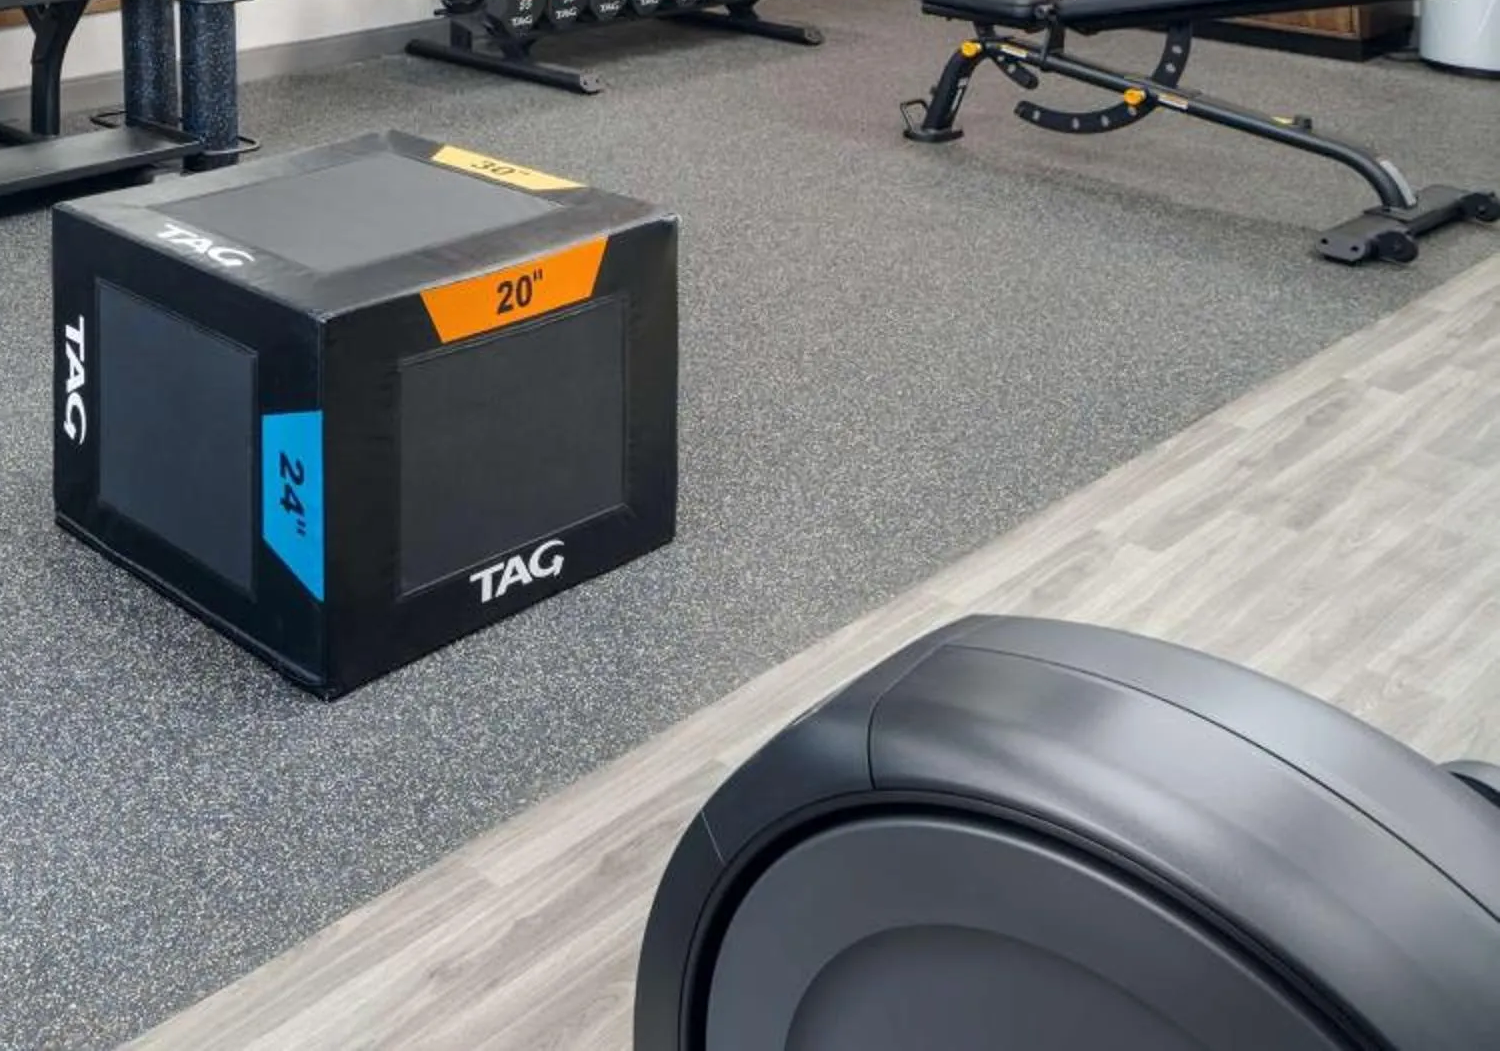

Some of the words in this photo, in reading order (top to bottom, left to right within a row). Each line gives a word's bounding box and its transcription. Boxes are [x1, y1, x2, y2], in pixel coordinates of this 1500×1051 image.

[471, 160, 530, 176] 30"
[155, 222, 256, 268] TAG
[496, 269, 544, 315] 20"
[63, 314, 87, 446] TAG
[279, 452, 307, 538] 24"
[469, 539, 565, 604] TAG
